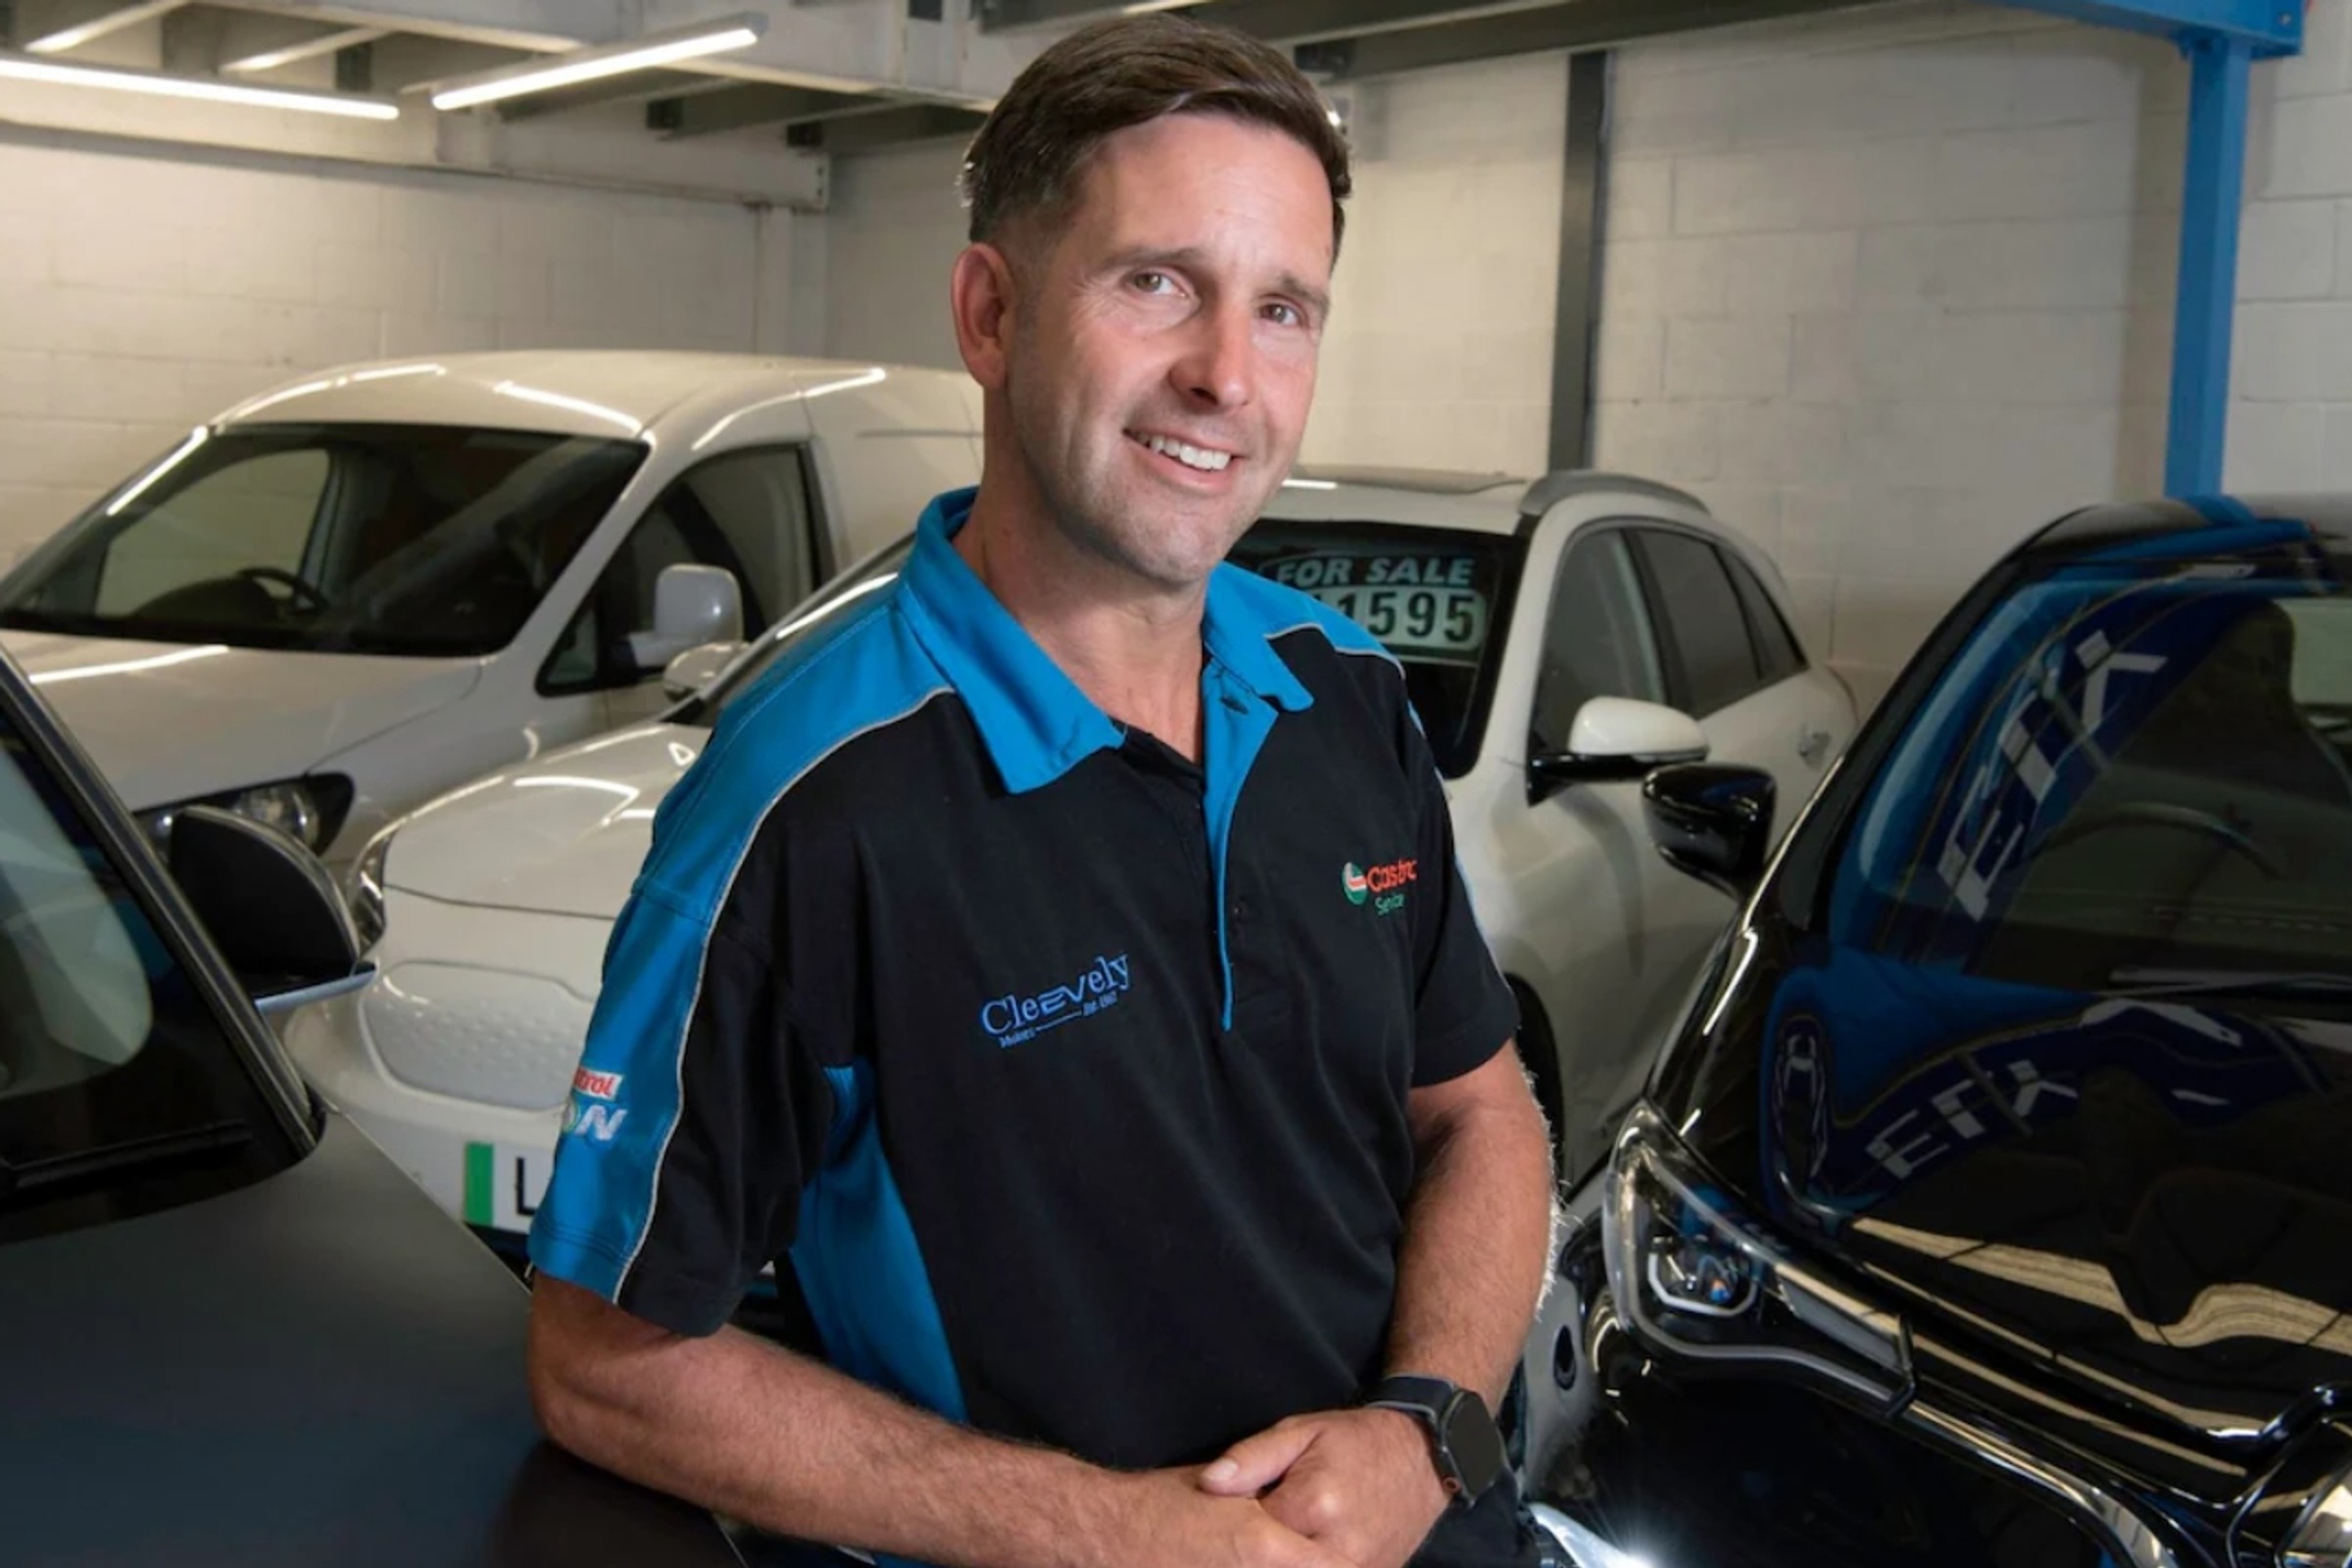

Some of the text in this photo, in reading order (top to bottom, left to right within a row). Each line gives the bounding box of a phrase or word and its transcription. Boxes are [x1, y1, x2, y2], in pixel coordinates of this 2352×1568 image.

[1276, 557, 1476, 586] FOR SALE
[1317, 590, 1475, 643] 1595
[1366, 858, 1418, 893] Castro
[573, 1067, 615, 1097] trol
